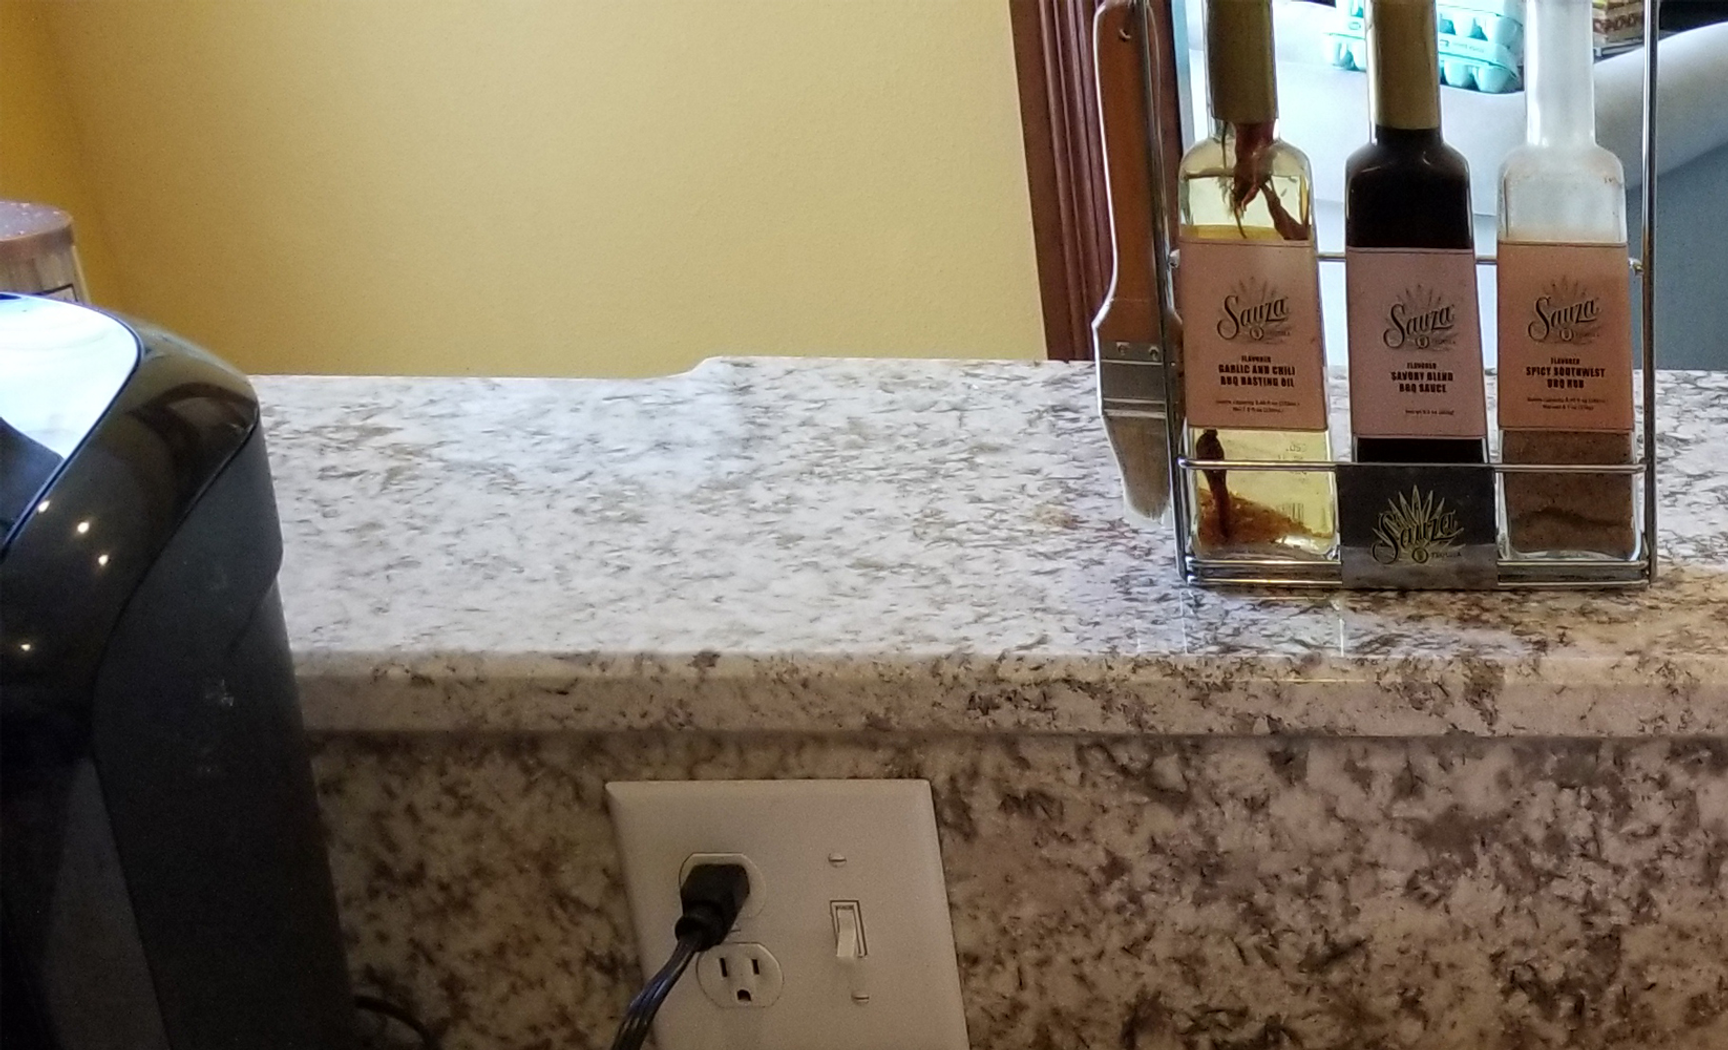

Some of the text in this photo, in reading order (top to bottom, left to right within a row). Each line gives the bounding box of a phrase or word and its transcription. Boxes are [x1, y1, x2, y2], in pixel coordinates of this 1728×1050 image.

[1217, 294, 1289, 340] Sauza
[1528, 296, 1599, 342] Sauza
[1383, 303, 1455, 348] Sauza
[1218, 364, 1295, 376] GARLIC AND CHILI
[1391, 371, 1453, 382] SAVORY BLEND
[1526, 366, 1605, 378] SPICY SOUTHWEST
[1220, 375, 1295, 388] BBQ BASTING OIL
[1399, 383, 1447, 393] BBQ SAUCE
[1371, 509, 1465, 565] Sauza
